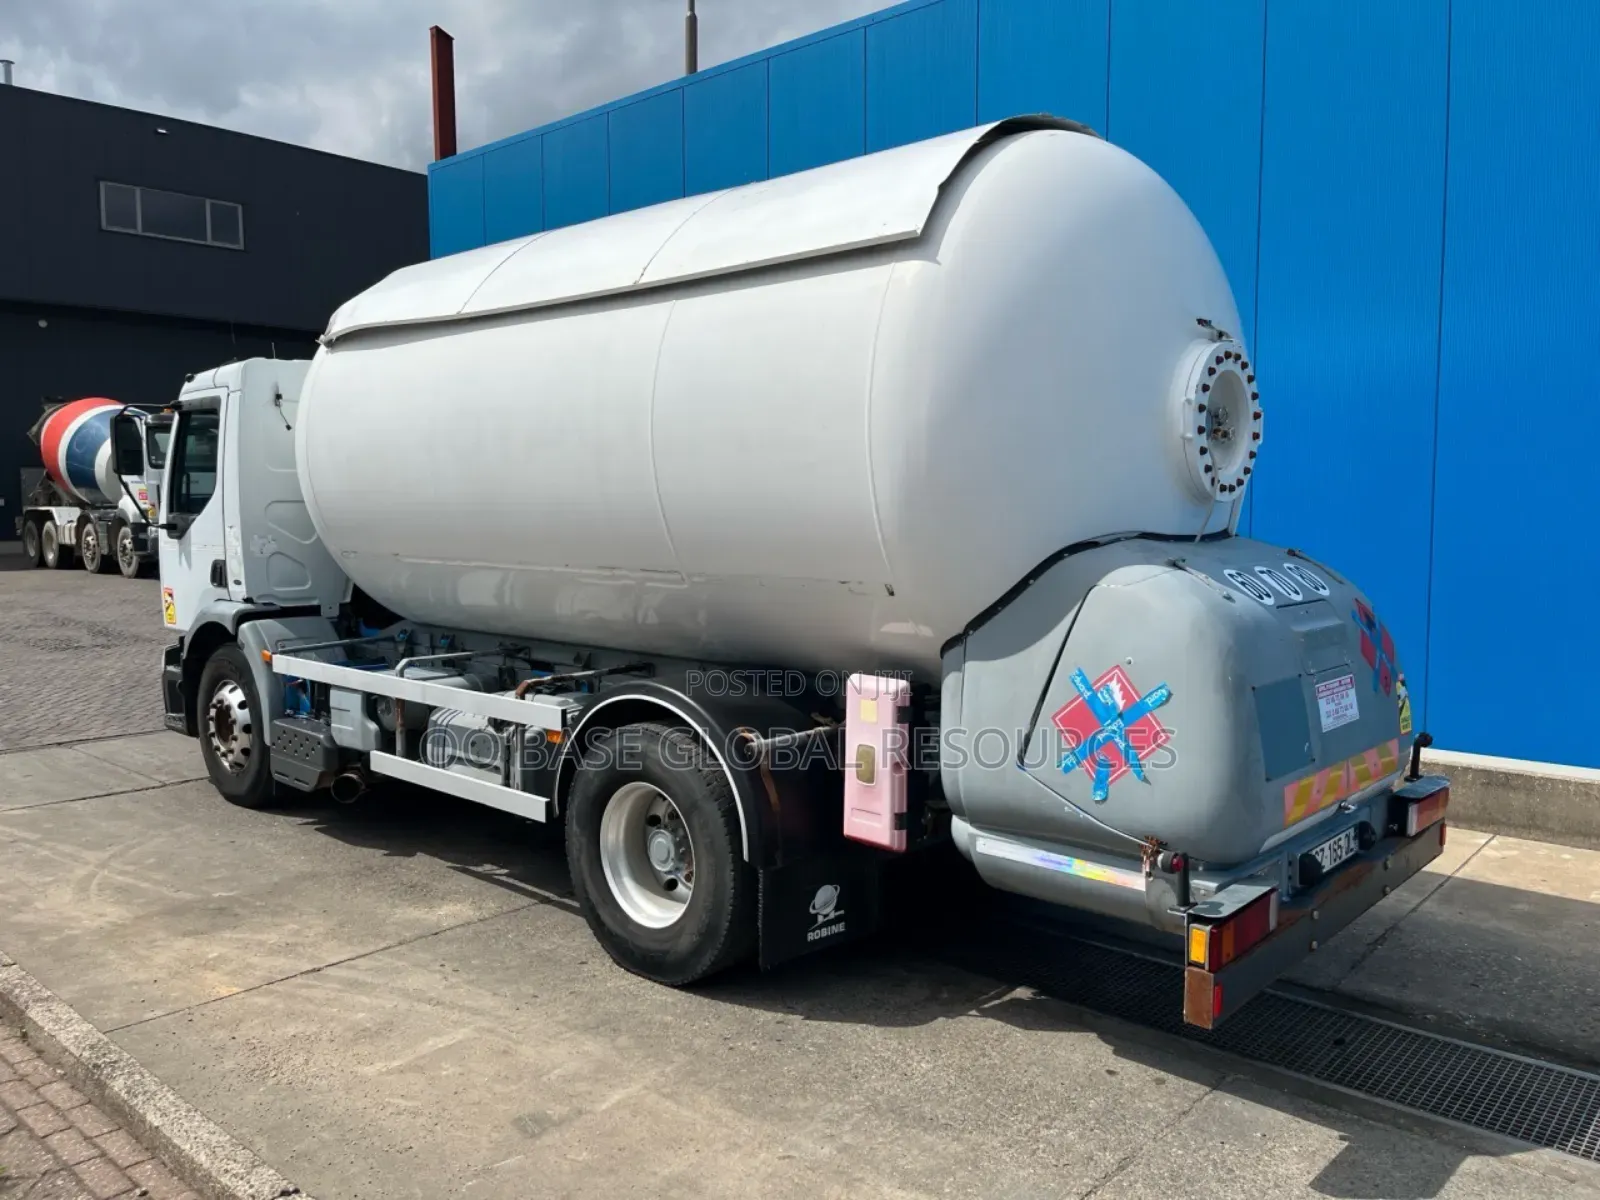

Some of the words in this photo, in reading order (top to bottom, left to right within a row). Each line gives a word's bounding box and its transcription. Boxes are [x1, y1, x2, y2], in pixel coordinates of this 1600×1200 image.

[1227, 571, 1272, 601] 60
[1258, 569, 1300, 596] 70
[1286, 565, 1327, 591] 80
[806, 921, 846, 942] ROBINE
